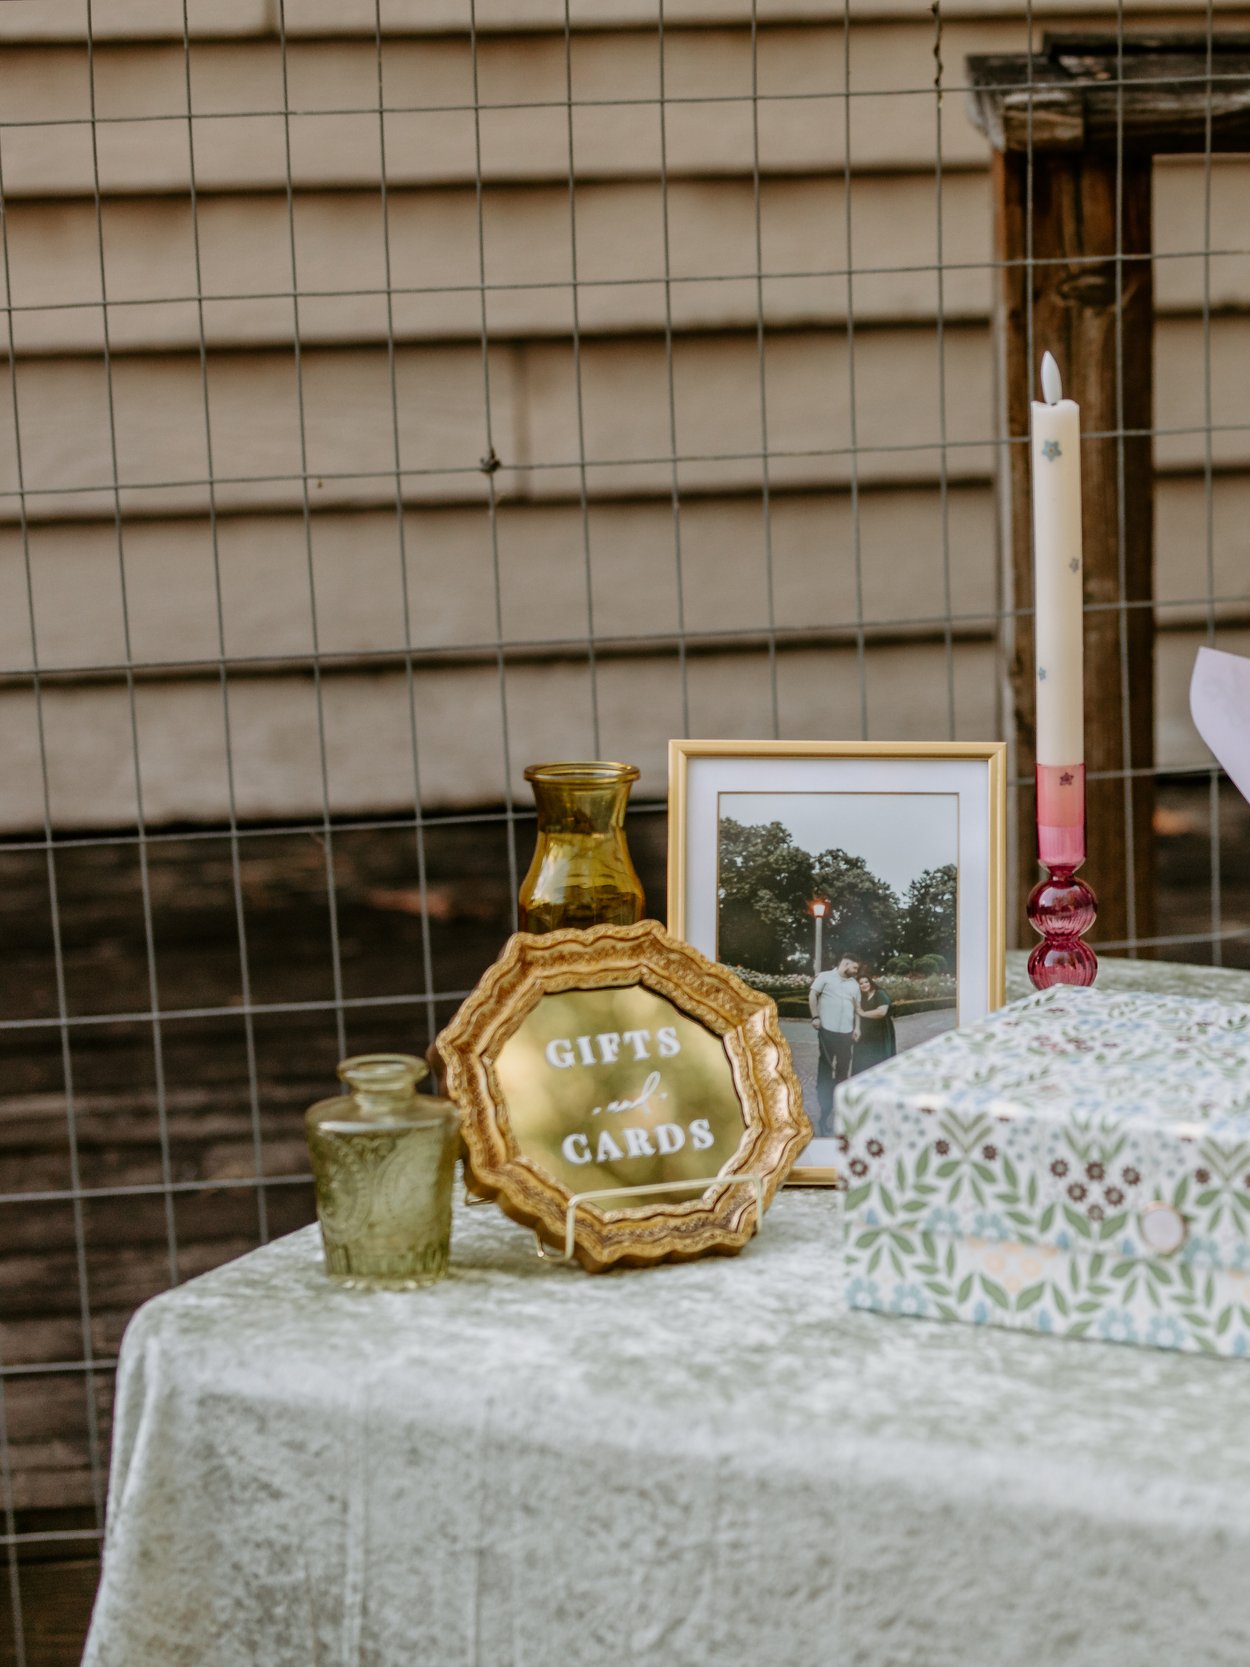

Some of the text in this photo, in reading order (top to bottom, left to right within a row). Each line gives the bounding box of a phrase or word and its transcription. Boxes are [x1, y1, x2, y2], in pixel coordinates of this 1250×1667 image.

[545, 1026, 681, 1069] GIFTS
[603, 1071, 662, 1114] and
[562, 1118, 715, 1165] CARDS
